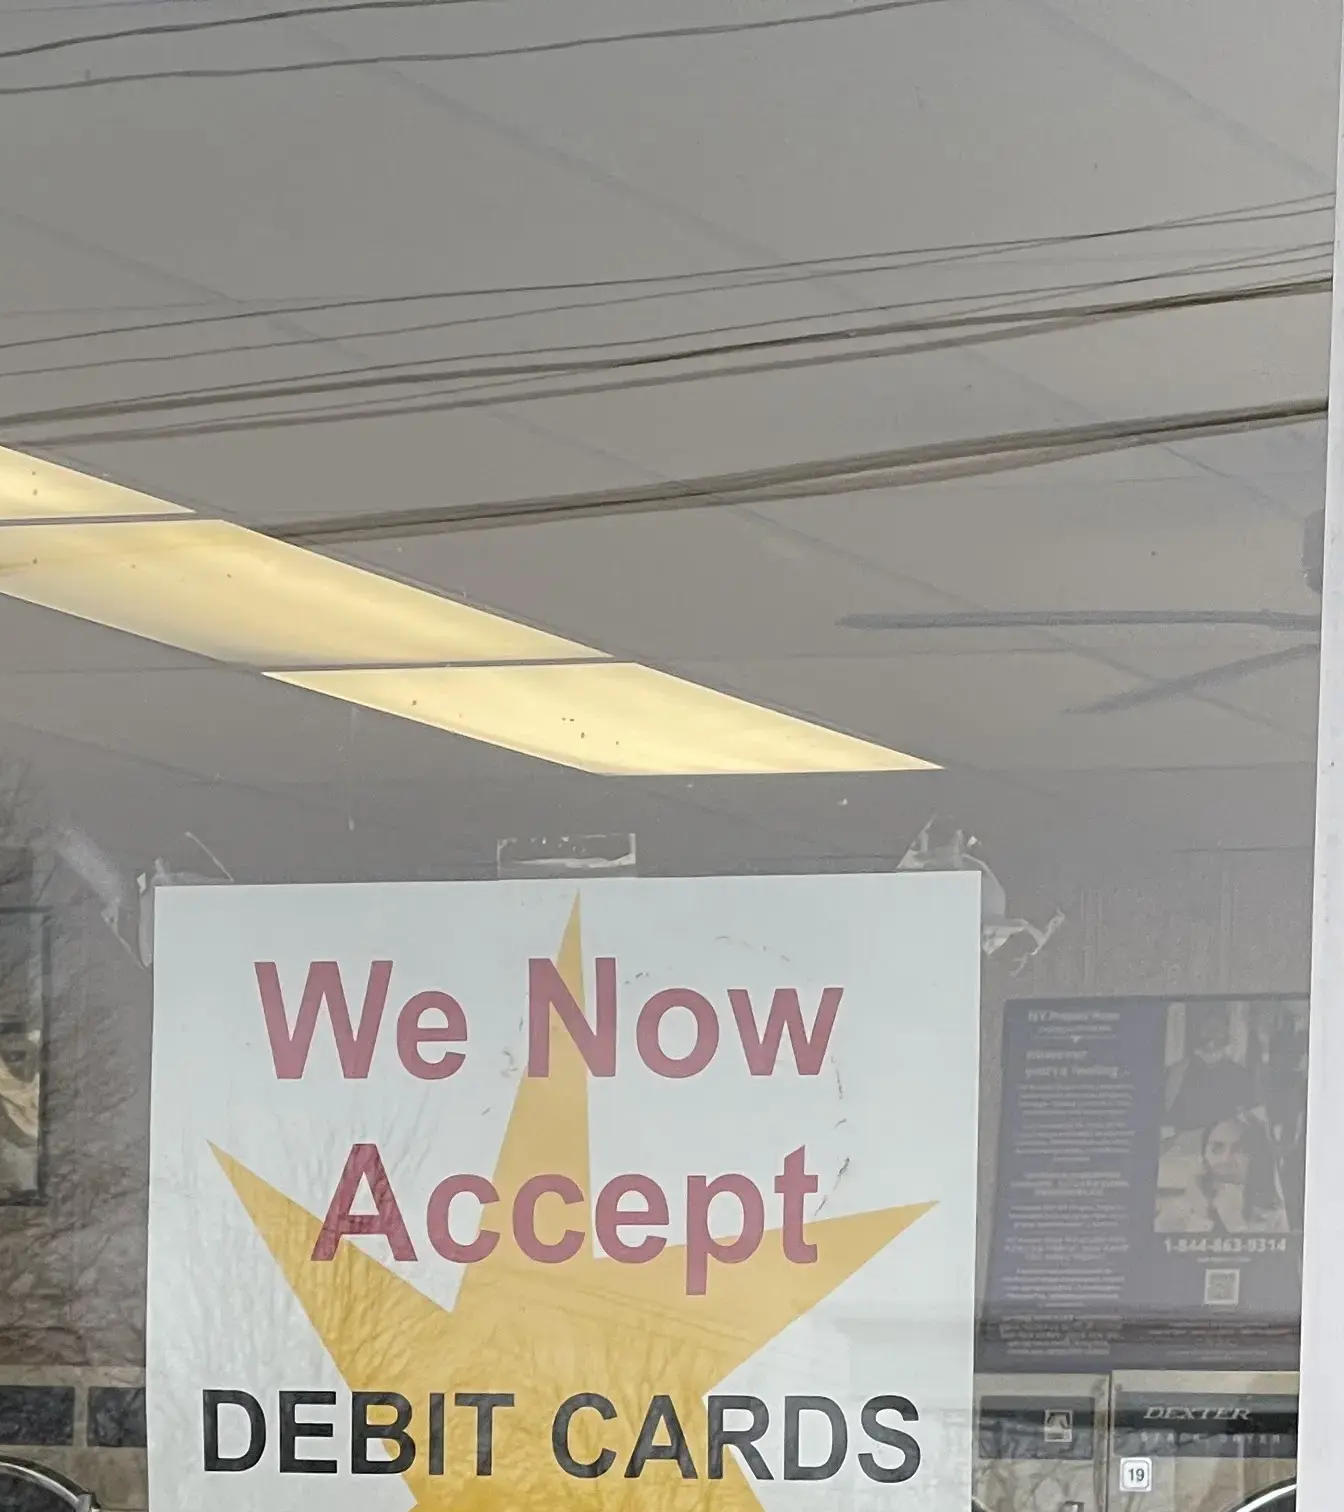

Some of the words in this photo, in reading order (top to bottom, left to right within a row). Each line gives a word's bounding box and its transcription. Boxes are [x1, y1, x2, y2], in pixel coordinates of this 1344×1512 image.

[254, 960, 467, 1080] We
[527, 957, 844, 1079] Now
[310, 1143, 819, 1297] Accept
[202, 1388, 515, 1477] DEBIT
[551, 1392, 922, 1485] CARDS
[1142, 1405, 1253, 1421] DEXTER
[1128, 1467, 1146, 1483] 19
